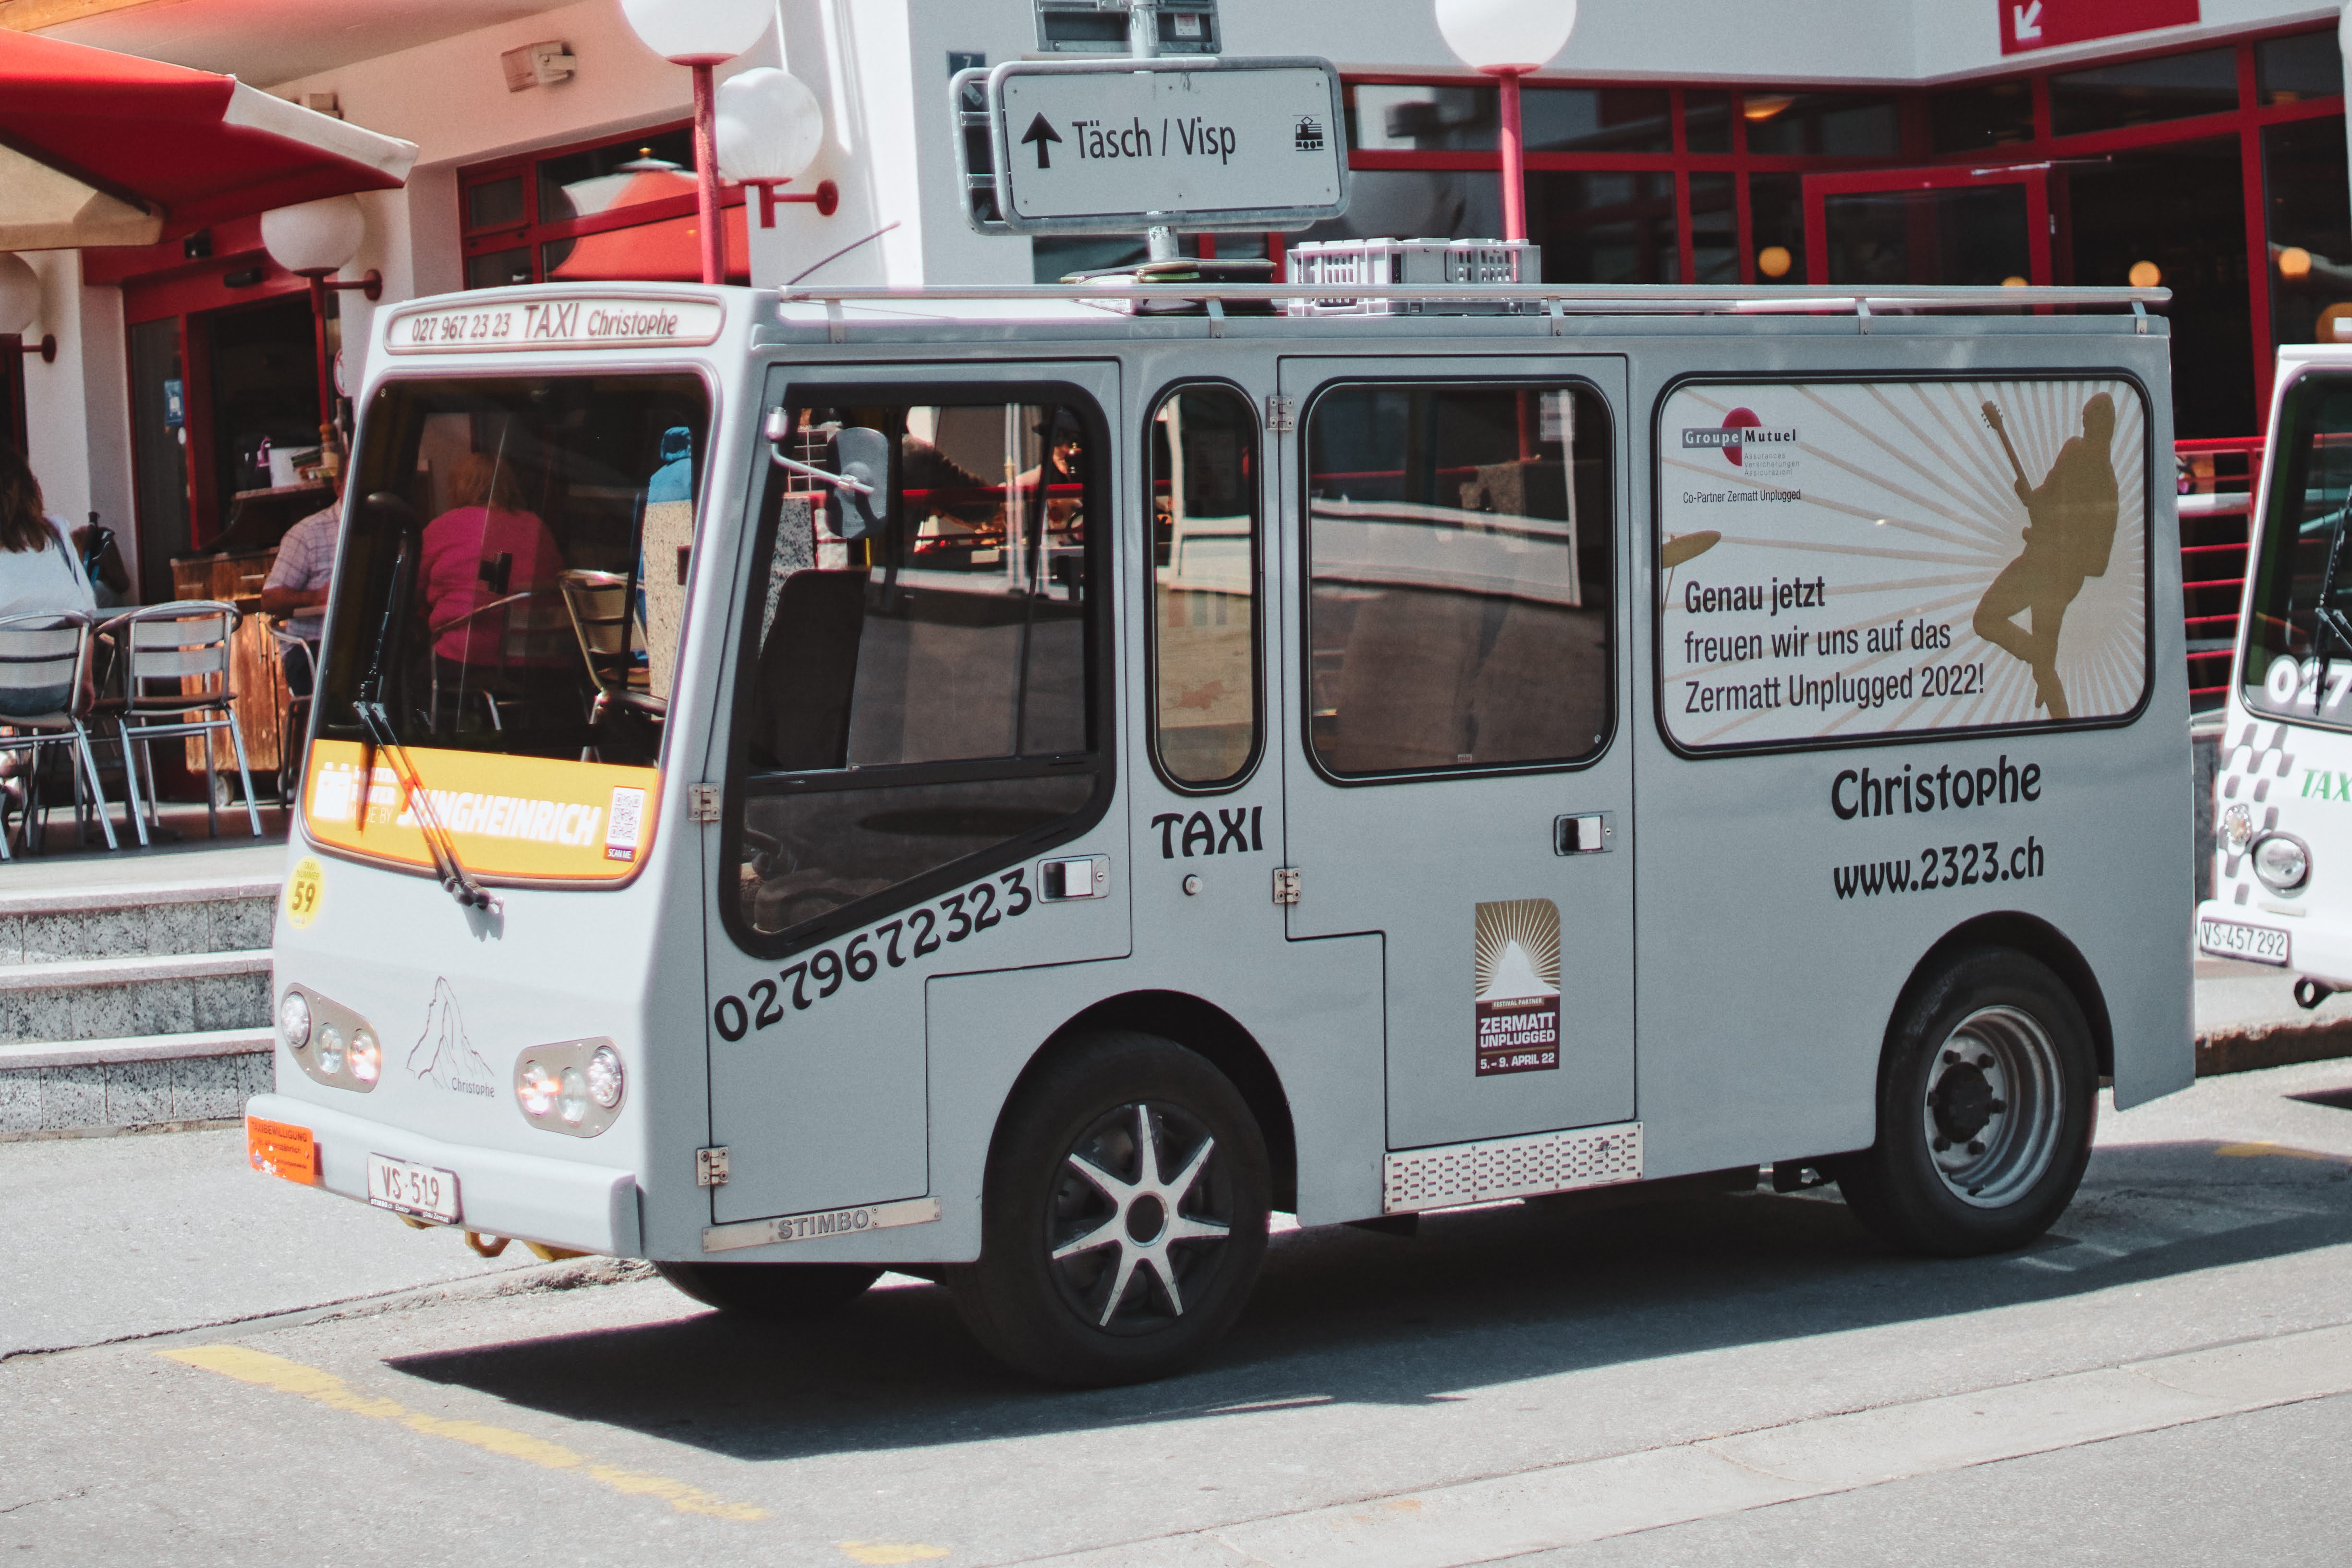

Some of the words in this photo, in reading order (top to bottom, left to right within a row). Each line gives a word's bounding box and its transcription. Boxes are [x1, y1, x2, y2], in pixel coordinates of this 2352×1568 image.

[1072, 117, 1152, 158] Täsch
[1177, 117, 1236, 165] Visp
[412, 317, 437, 341] 027
[440, 316, 467, 340] 967
[470, 314, 489, 338] 23
[491, 313, 510, 337] 23
[524, 303, 580, 338] TAXI
[587, 308, 679, 336] Christophe
[1685, 431, 1739, 447] Groupe
[1745, 429, 1796, 442] Mutuel
[1744, 460, 1800, 468] Versicherungen
[1683, 491, 1725, 503] Co-Partner
[1727, 490, 1758, 502] Zermatt
[1760, 488, 1801, 503] Unplugged
[1685, 580, 1763, 613] Genau
[1770, 576, 1825, 616] jetzt
[1685, 630, 1763, 663] freuen
[1771, 625, 1809, 658] wir
[1817, 628, 1859, 656] uns
[1867, 620, 1904, 653] auf
[1911, 619, 1951, 649] das
[1685, 677, 1781, 714] Zermatt
[1789, 667, 1913, 711] Unplugged
[1921, 663, 1985, 698] 2022!
[1831, 754, 2041, 820] Christophe
[379, 806, 393, 824] BY
[397, 787, 602, 846] JUNGHEINRICH
[1151, 806, 1263, 859] TAXI
[304, 861, 315, 871] TAXI
[608, 848, 622, 858] SCAN
[622, 850, 632, 859] ME
[296, 869, 319, 880] NUMMER
[1833, 836, 2044, 900] www.2323.ch
[292, 880, 315, 912] 59
[714, 867, 1032, 1042] 0279672323
[2257, 931, 2284, 957] 292
[1518, 997, 1542, 1006] PARTNER
[1480, 1011, 1555, 1034] ZERMATT
[1480, 1029, 1555, 1048] UNPLUGGED
[1511, 1054, 1540, 1067] APRIL
[1541, 1052, 1555, 1064] 22
[452, 1076, 495, 1098] Christophe
[251, 1121, 308, 1142] TAXIBEWILLIGUNG
[371, 1198, 393, 1209] STIMBO.ch
[433, 1212, 449, 1223] Zermatt
[777, 1209, 869, 1239] STIMBO
